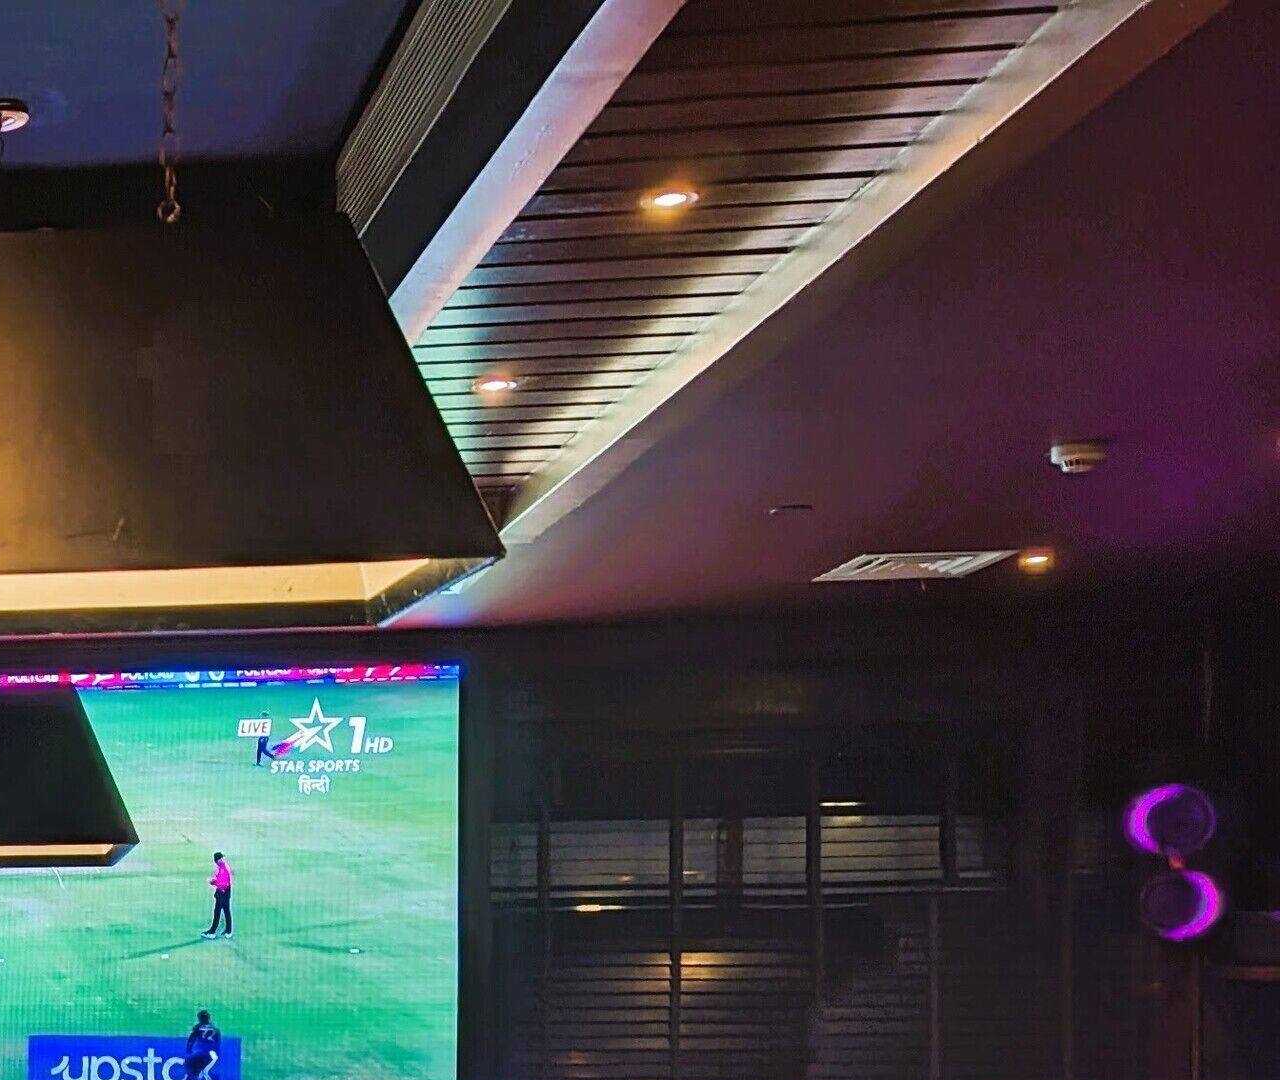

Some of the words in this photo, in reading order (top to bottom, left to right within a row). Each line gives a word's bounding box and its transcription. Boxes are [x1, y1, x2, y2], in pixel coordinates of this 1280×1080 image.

[240, 721, 269, 734] LIVE
[348, 716, 367, 753] 1
[364, 737, 394, 753] HD
[270, 760, 305, 774] STAR
[308, 759, 361, 773] SPORTS
[298, 775, 331, 795] हिन्दी
